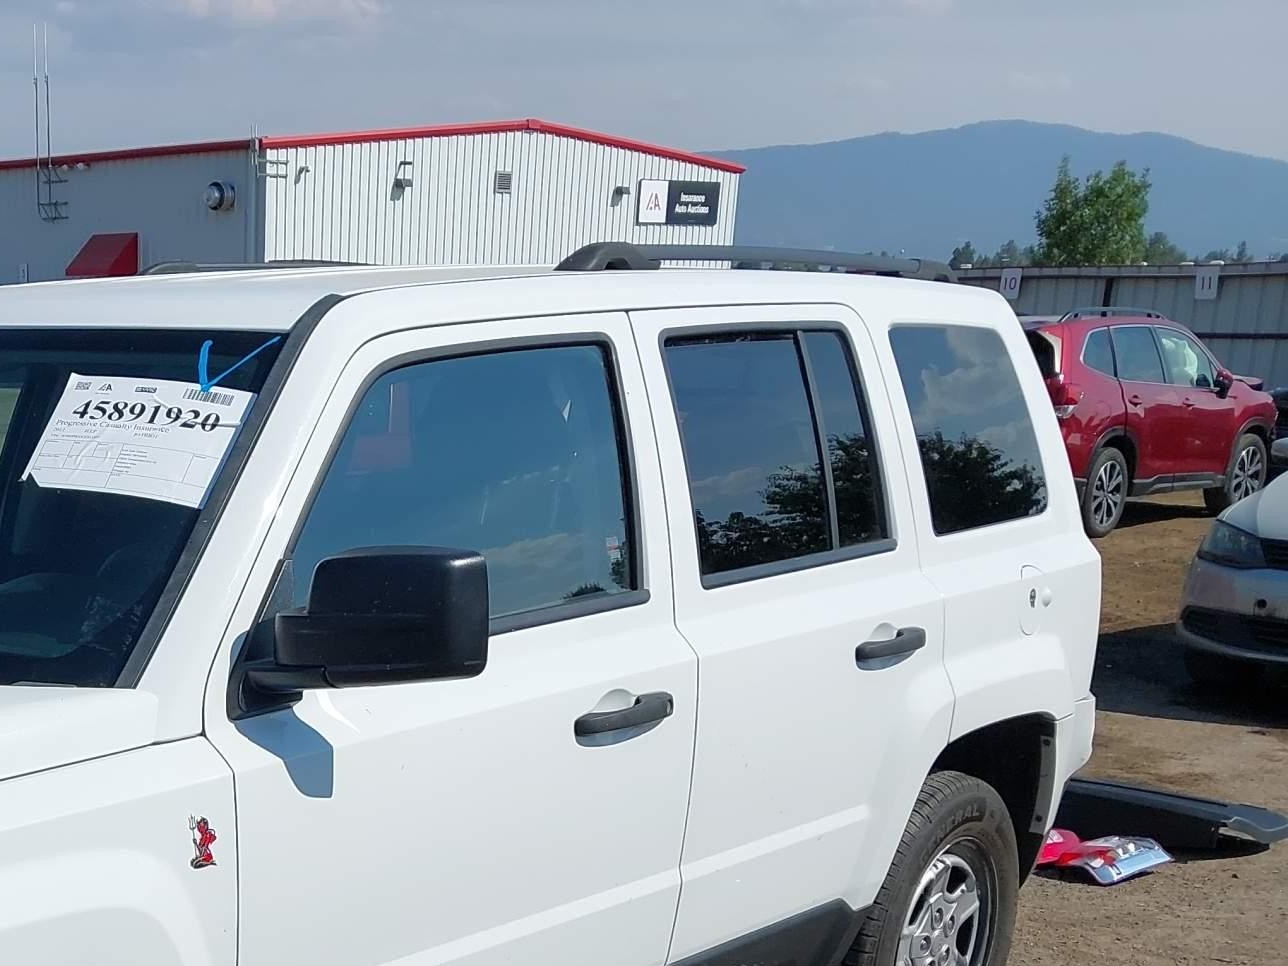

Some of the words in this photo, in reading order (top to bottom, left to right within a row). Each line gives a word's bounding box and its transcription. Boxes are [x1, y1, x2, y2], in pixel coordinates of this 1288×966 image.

[1003, 277, 1017, 290] 10
[1201, 276, 1212, 290] 11
[72, 399, 221, 433] 45891920
[55, 418, 98, 429] Progressive
[99, 420, 131, 431] Casualty
